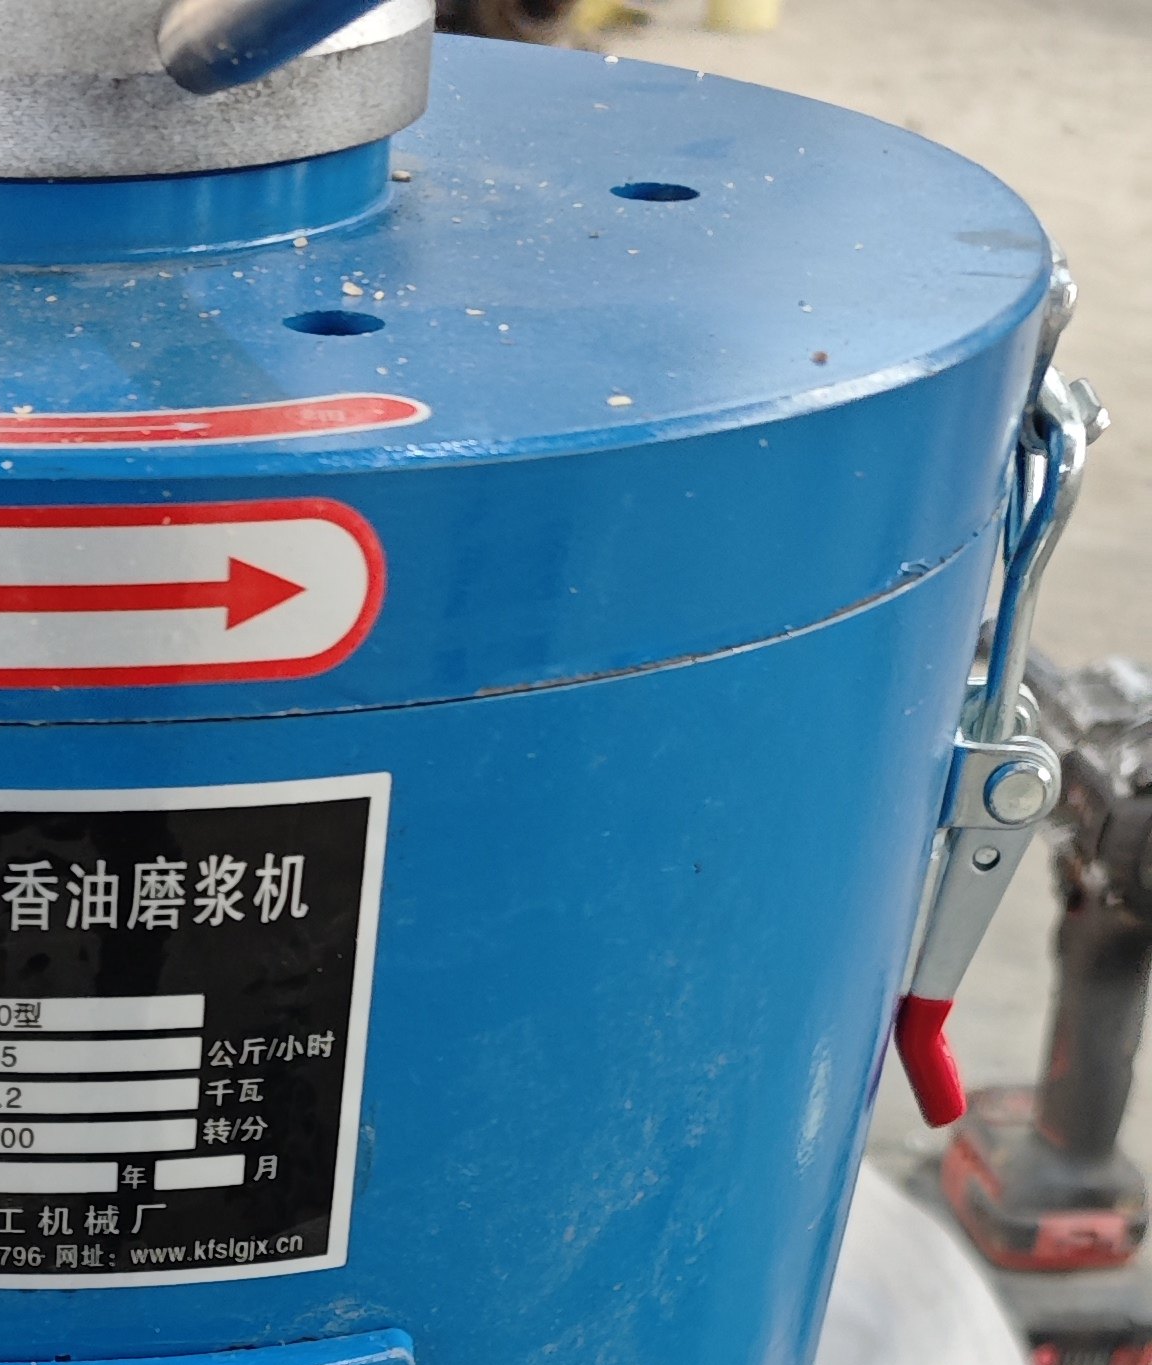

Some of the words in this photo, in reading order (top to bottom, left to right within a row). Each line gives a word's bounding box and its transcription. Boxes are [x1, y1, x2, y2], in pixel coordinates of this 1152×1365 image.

[208, 1030, 336, 1069] 公斤/小时
[205, 1077, 265, 1106] 千瓦
[202, 1115, 268, 1144] 转/分
[120, 1164, 147, 1189] 年
[252, 1154, 278, 1181] 月
